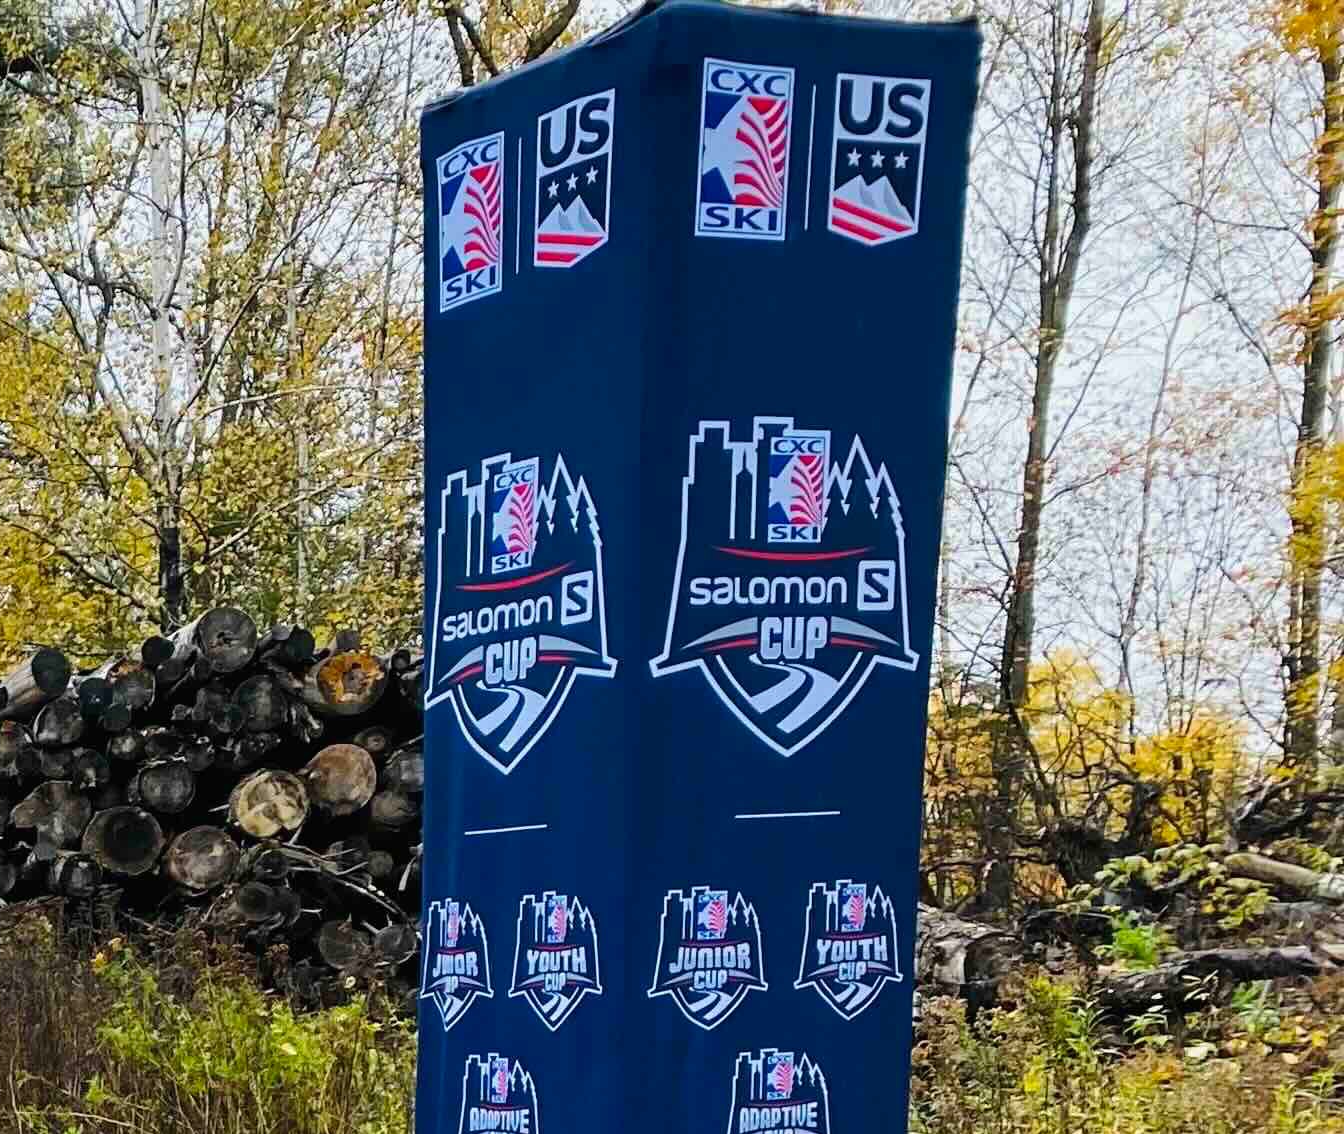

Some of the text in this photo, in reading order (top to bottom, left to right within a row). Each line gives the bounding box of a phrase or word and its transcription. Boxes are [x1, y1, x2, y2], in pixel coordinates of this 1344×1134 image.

[711, 68, 787, 96] CXC
[837, 79, 926, 138] US
[539, 98, 611, 168] US
[442, 140, 499, 180] CXC
[703, 206, 779, 231] SKI
[445, 266, 498, 300] SKI
[773, 438, 823, 454] CXC
[495, 469, 533, 489] CXC
[770, 525, 819, 542] SKI
[494, 551, 530, 571] SKI
[689, 575, 847, 606] salomon
[442, 594, 553, 643] salomon
[759, 616, 828, 659] CUP
[483, 636, 538, 685] CUP
[527, 947, 587, 975] YOUTH
[669, 943, 751, 973] JUNIOR
[816, 936, 889, 965] YOUTH
[545, 972, 568, 991] CUP
[694, 969, 728, 990] CUP
[838, 961, 867, 981] CUP
[739, 1102, 818, 1134] ADAPTIVE
